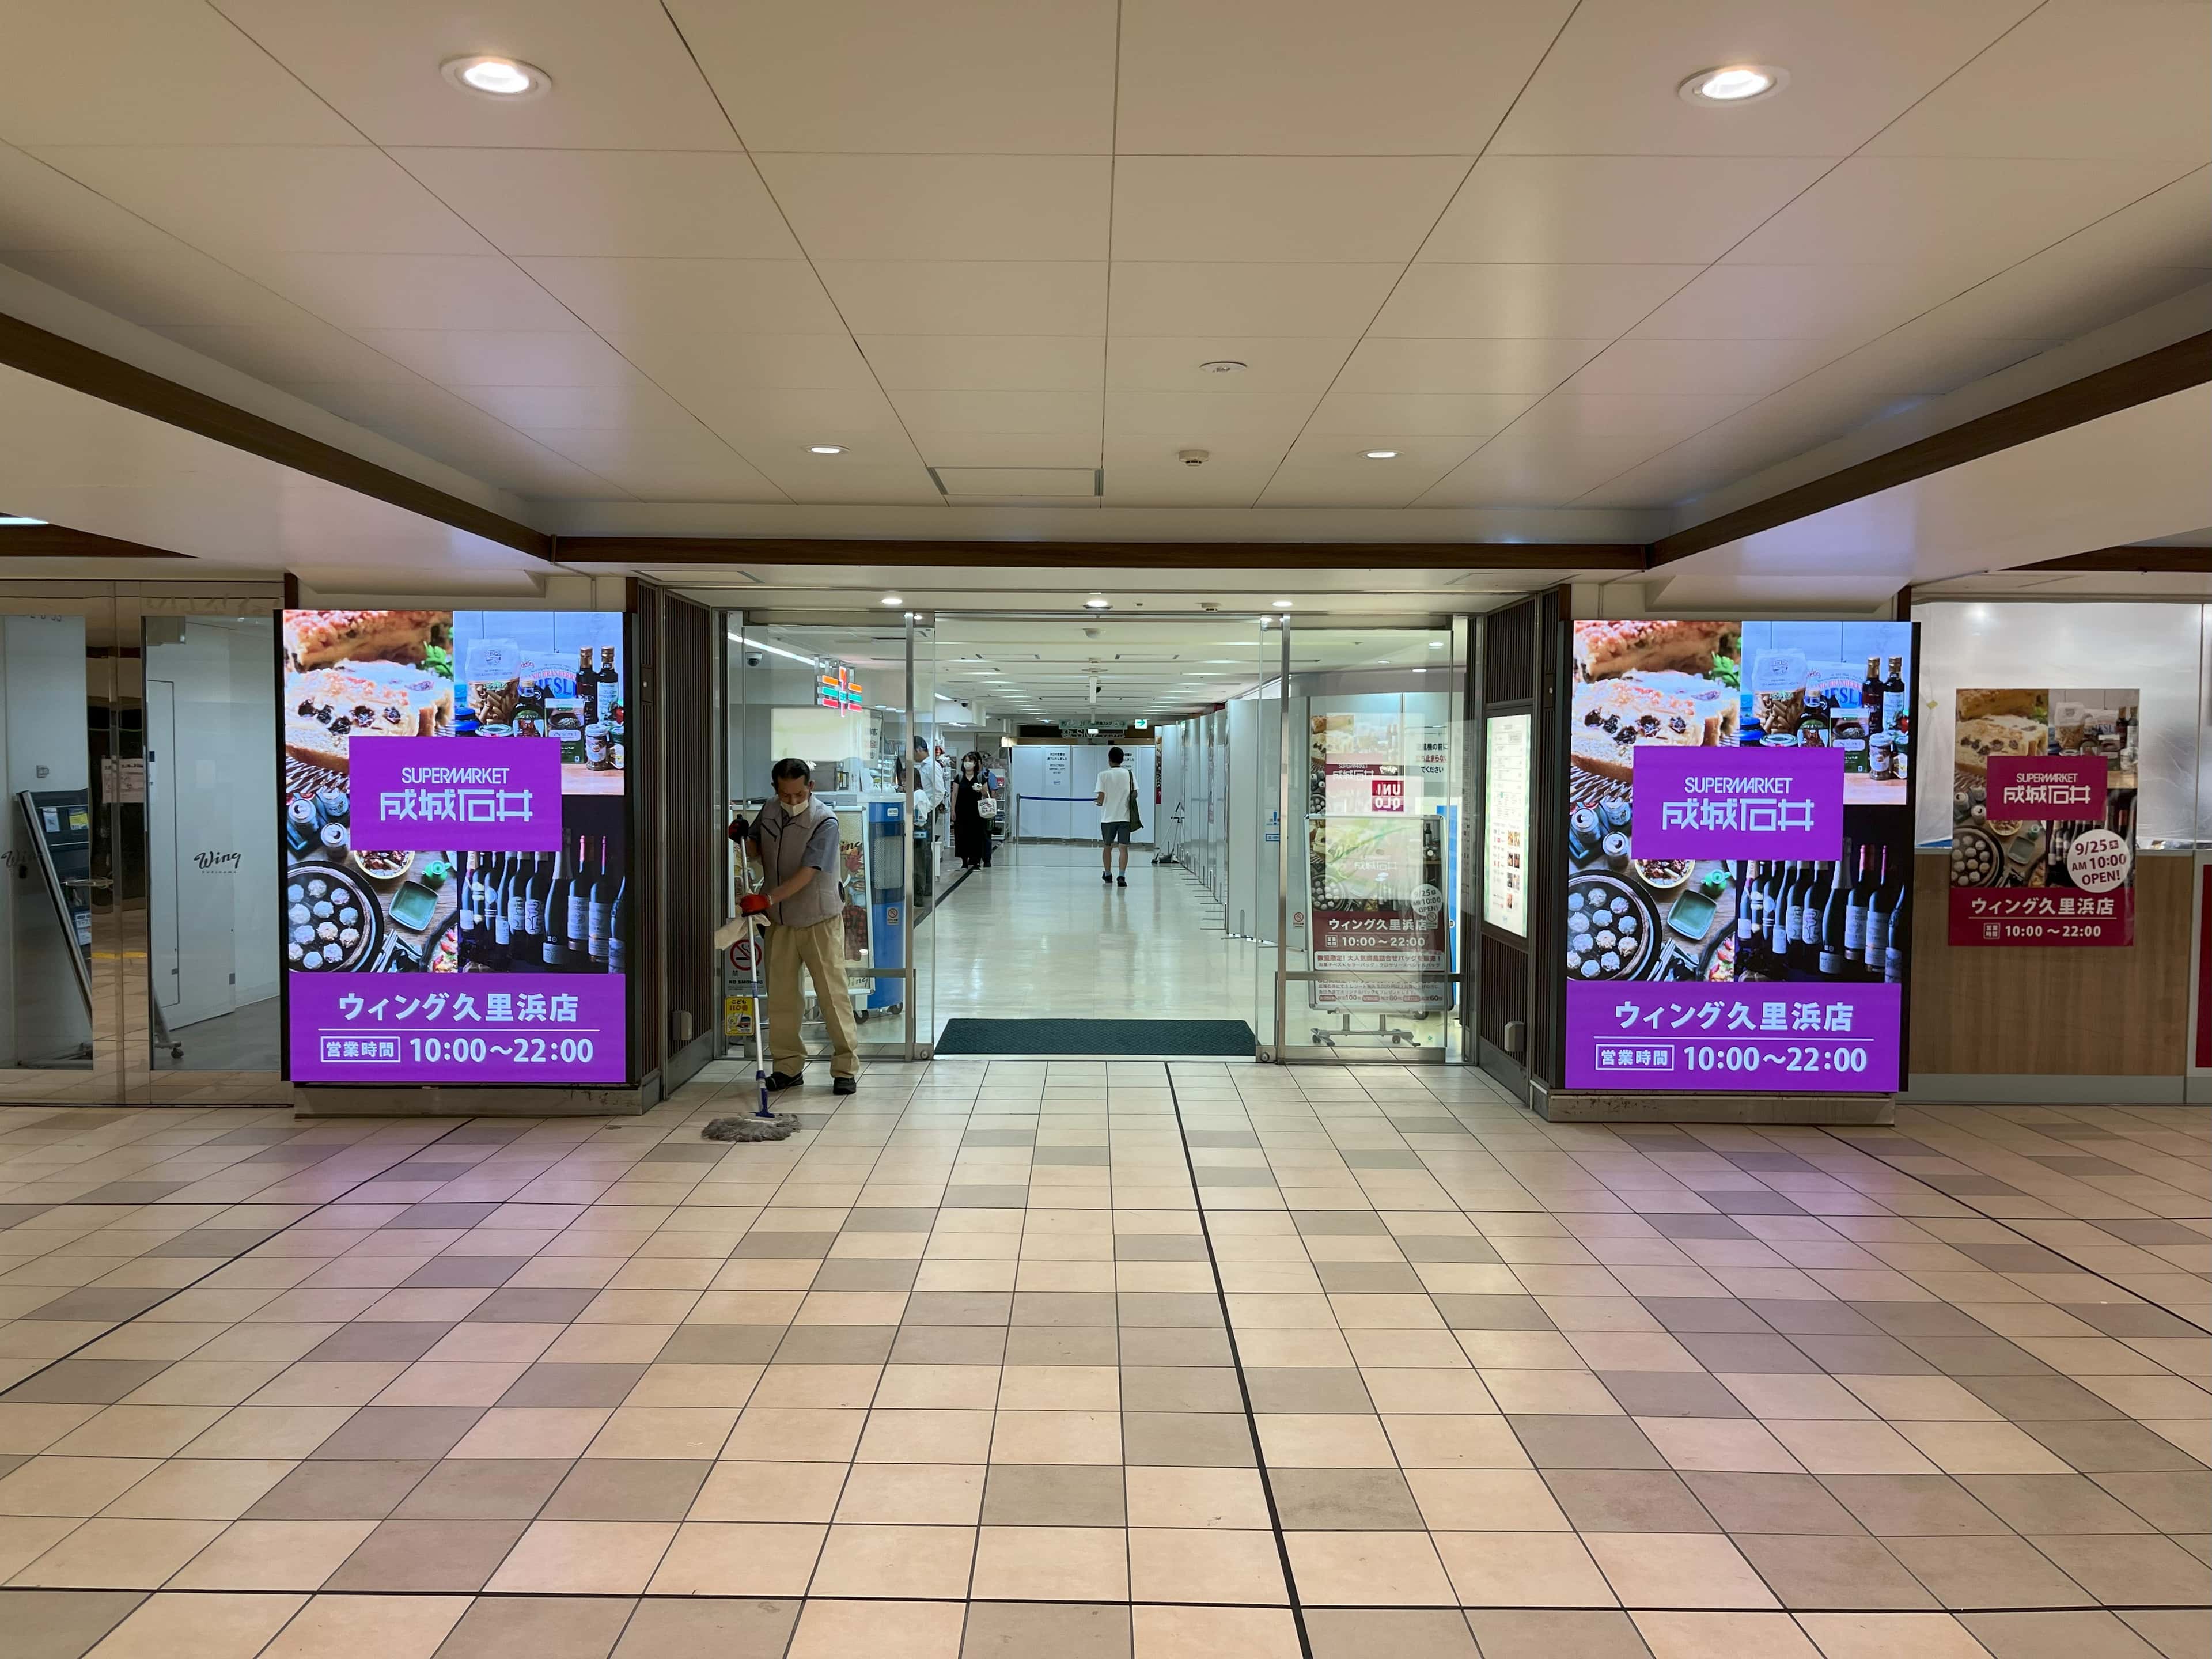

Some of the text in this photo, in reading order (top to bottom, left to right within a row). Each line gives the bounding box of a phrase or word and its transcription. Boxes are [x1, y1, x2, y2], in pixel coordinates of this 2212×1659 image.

[401, 767, 510, 785] SUPERMARKET
[2016, 772, 2078, 783] SUPERMARKET
[1684, 777, 1793, 794] SUPERMARKET
[2003, 785, 2091, 805] 成城石井
[380, 789, 533, 822] 成城石井
[1662, 798, 1815, 831] 成城石井
[2075, 839, 2107, 856] 9/25
[193, 850, 241, 869] Wing
[2071, 853, 2127, 872] AM 10:00
[2081, 870, 2120, 885] OPEN!
[1421, 896, 1441, 905] 10:00
[1971, 897, 2115, 915] ウィング久里浜店
[1328, 918, 1427, 931] ウィング久里浜店
[2005, 925, 2043, 937] 10:00
[2062, 925, 2101, 937] 22:00
[1342, 937, 1376, 946] 10:00
[1390, 937, 1425, 946] 22:00
[339, 993, 579, 1022] ウィング久里浜店
[1615, 1001, 1854, 1032] ウィング久里浜店
[326, 1040, 395, 1058] 営業時間
[1601, 1049, 1668, 1067] 営業時間
